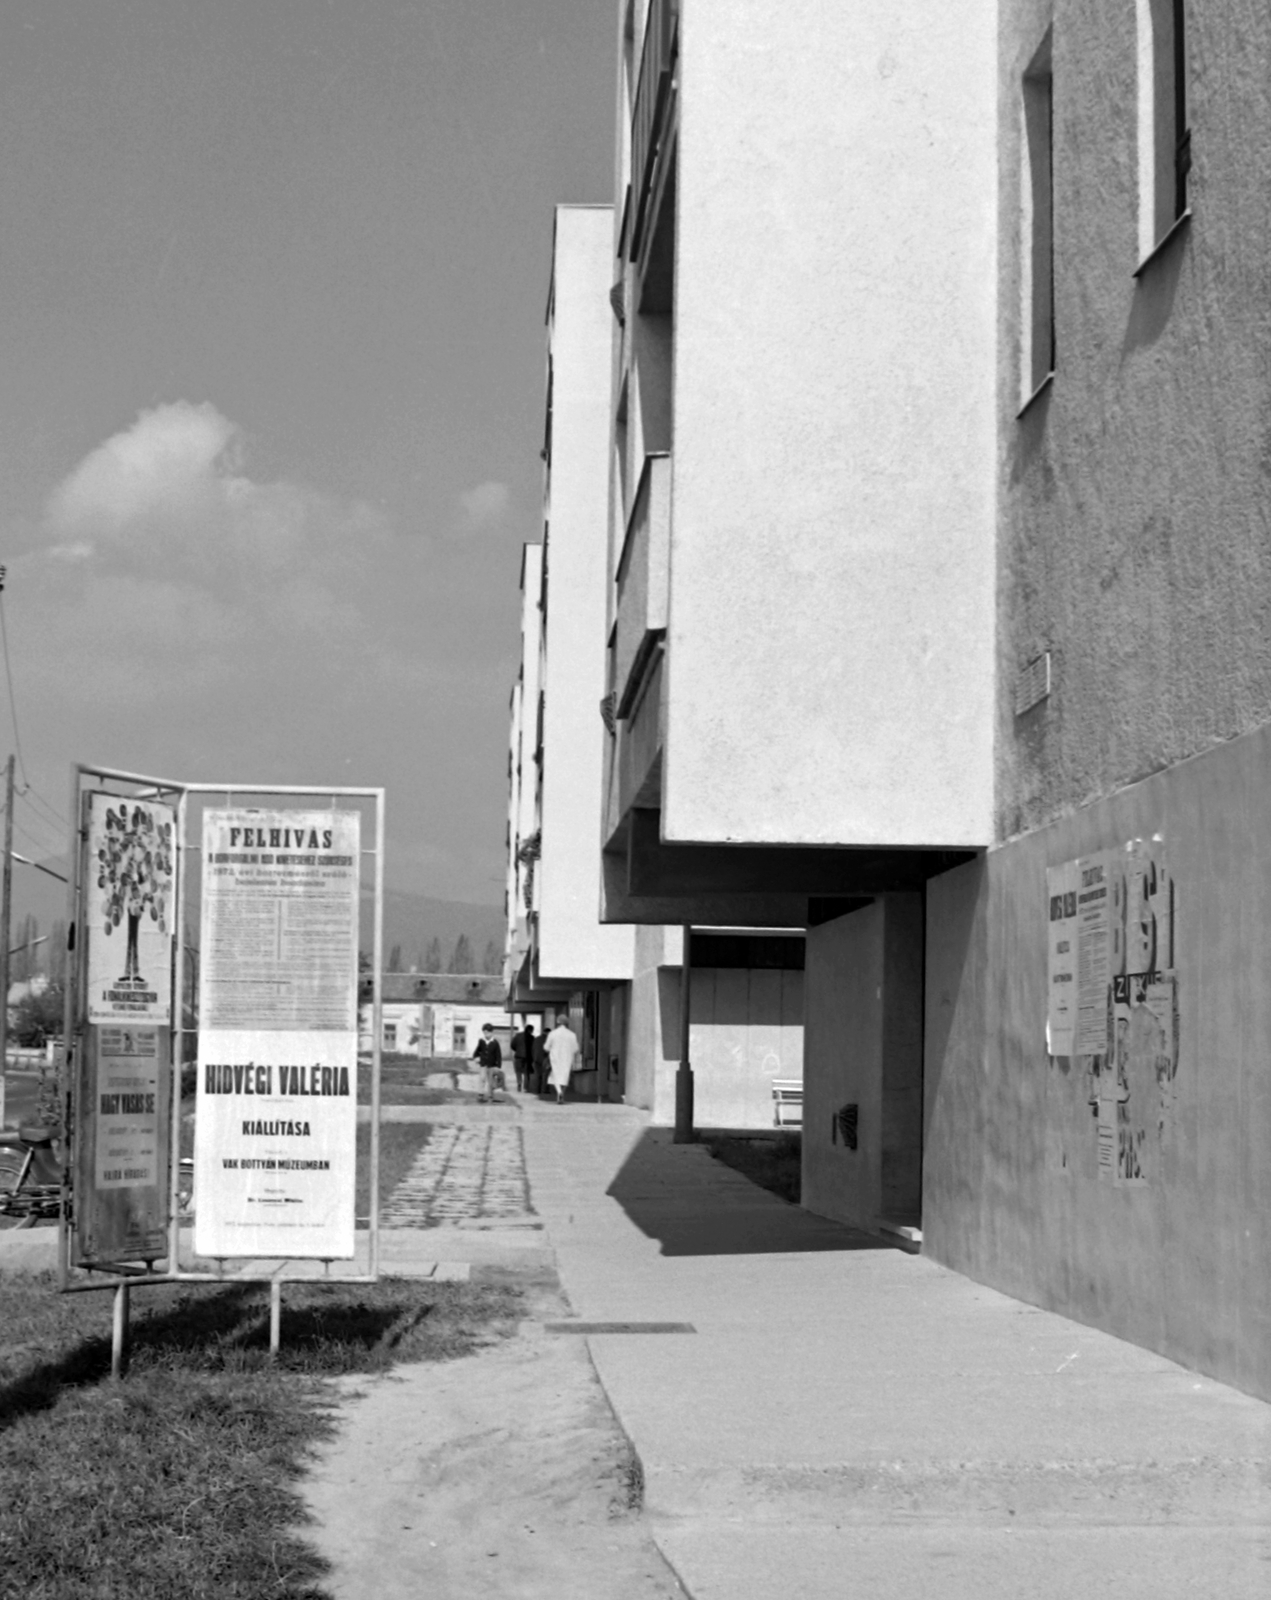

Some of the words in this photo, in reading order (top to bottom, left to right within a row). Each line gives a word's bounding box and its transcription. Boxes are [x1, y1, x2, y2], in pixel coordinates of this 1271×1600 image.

[205, 1061, 273, 1095] HIDVÉGI
[278, 1063, 350, 1096] VALÉRIA
[242, 1118, 311, 1136] KIÁLLÍTÁSA
[222, 1158, 239, 1169] VAK
[240, 1157, 276, 1170] BOTTYÁN
[277, 1158, 331, 1171] MÚZEUMBAN
